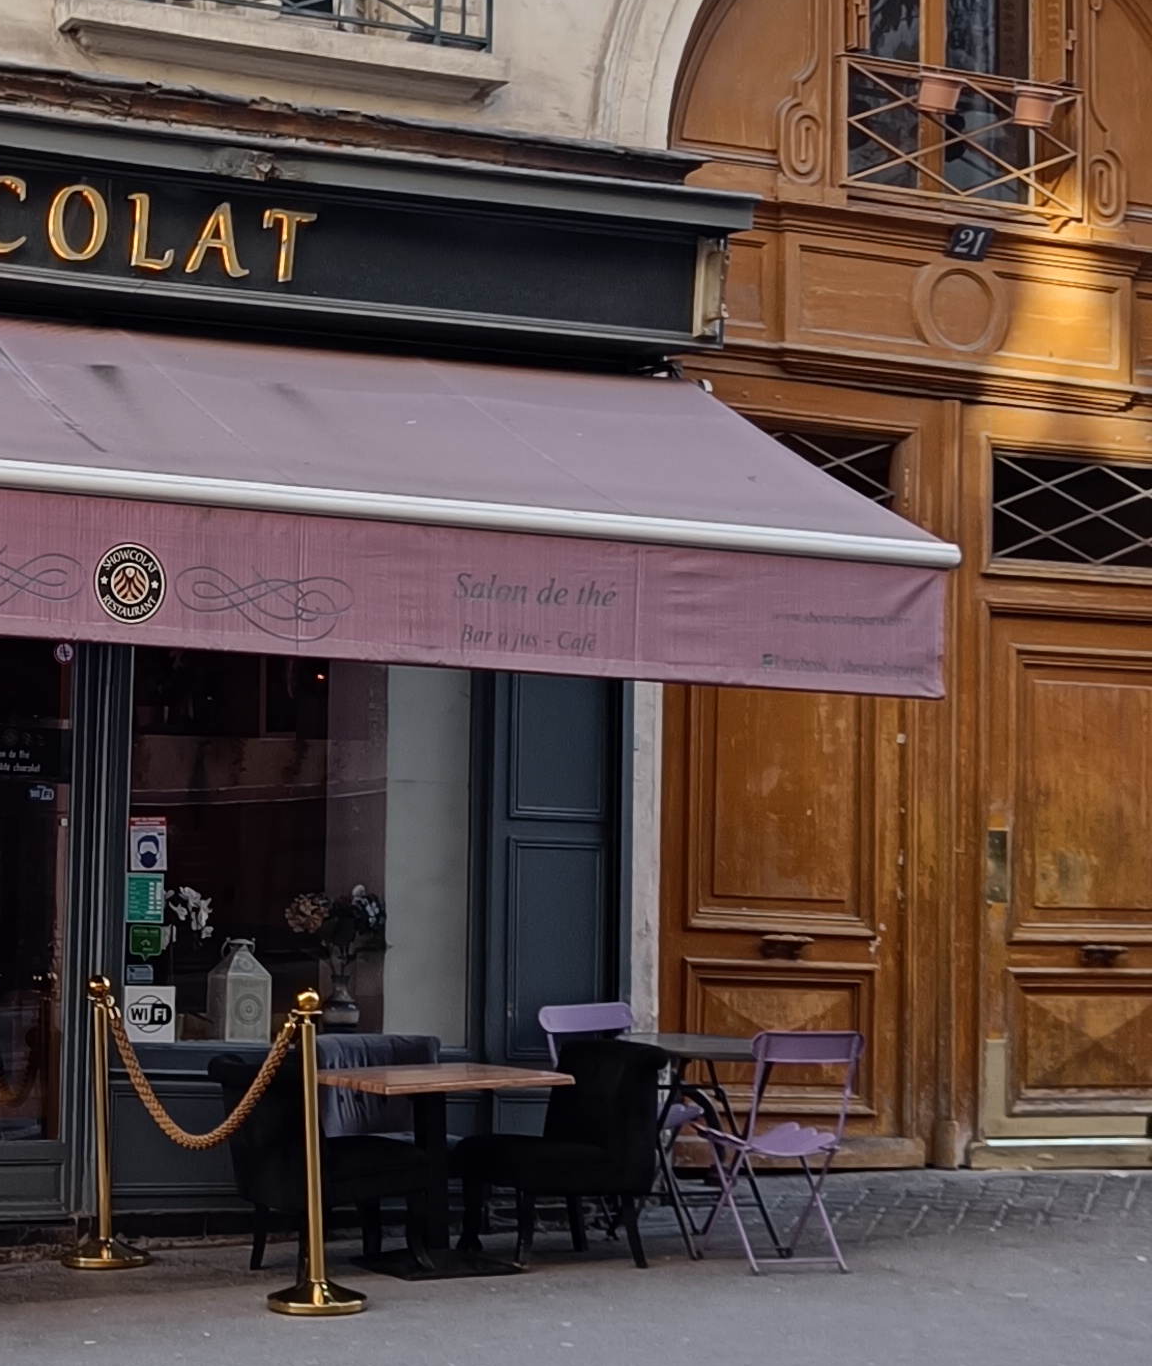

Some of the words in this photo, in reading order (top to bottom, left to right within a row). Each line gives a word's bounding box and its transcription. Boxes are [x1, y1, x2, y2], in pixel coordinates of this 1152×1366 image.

[953, 229, 985, 255] 21
[102, 548, 159, 573] SHOWCOLAT
[454, 572, 528, 604] Salon
[536, 578, 568, 605] de
[577, 580, 618, 607] thé
[101, 594, 157, 618] RESTAURANT
[461, 623, 493, 644] Bar
[498, 627, 508, 646] à
[512, 630, 539, 651] jus
[557, 630, 597, 656] Café
